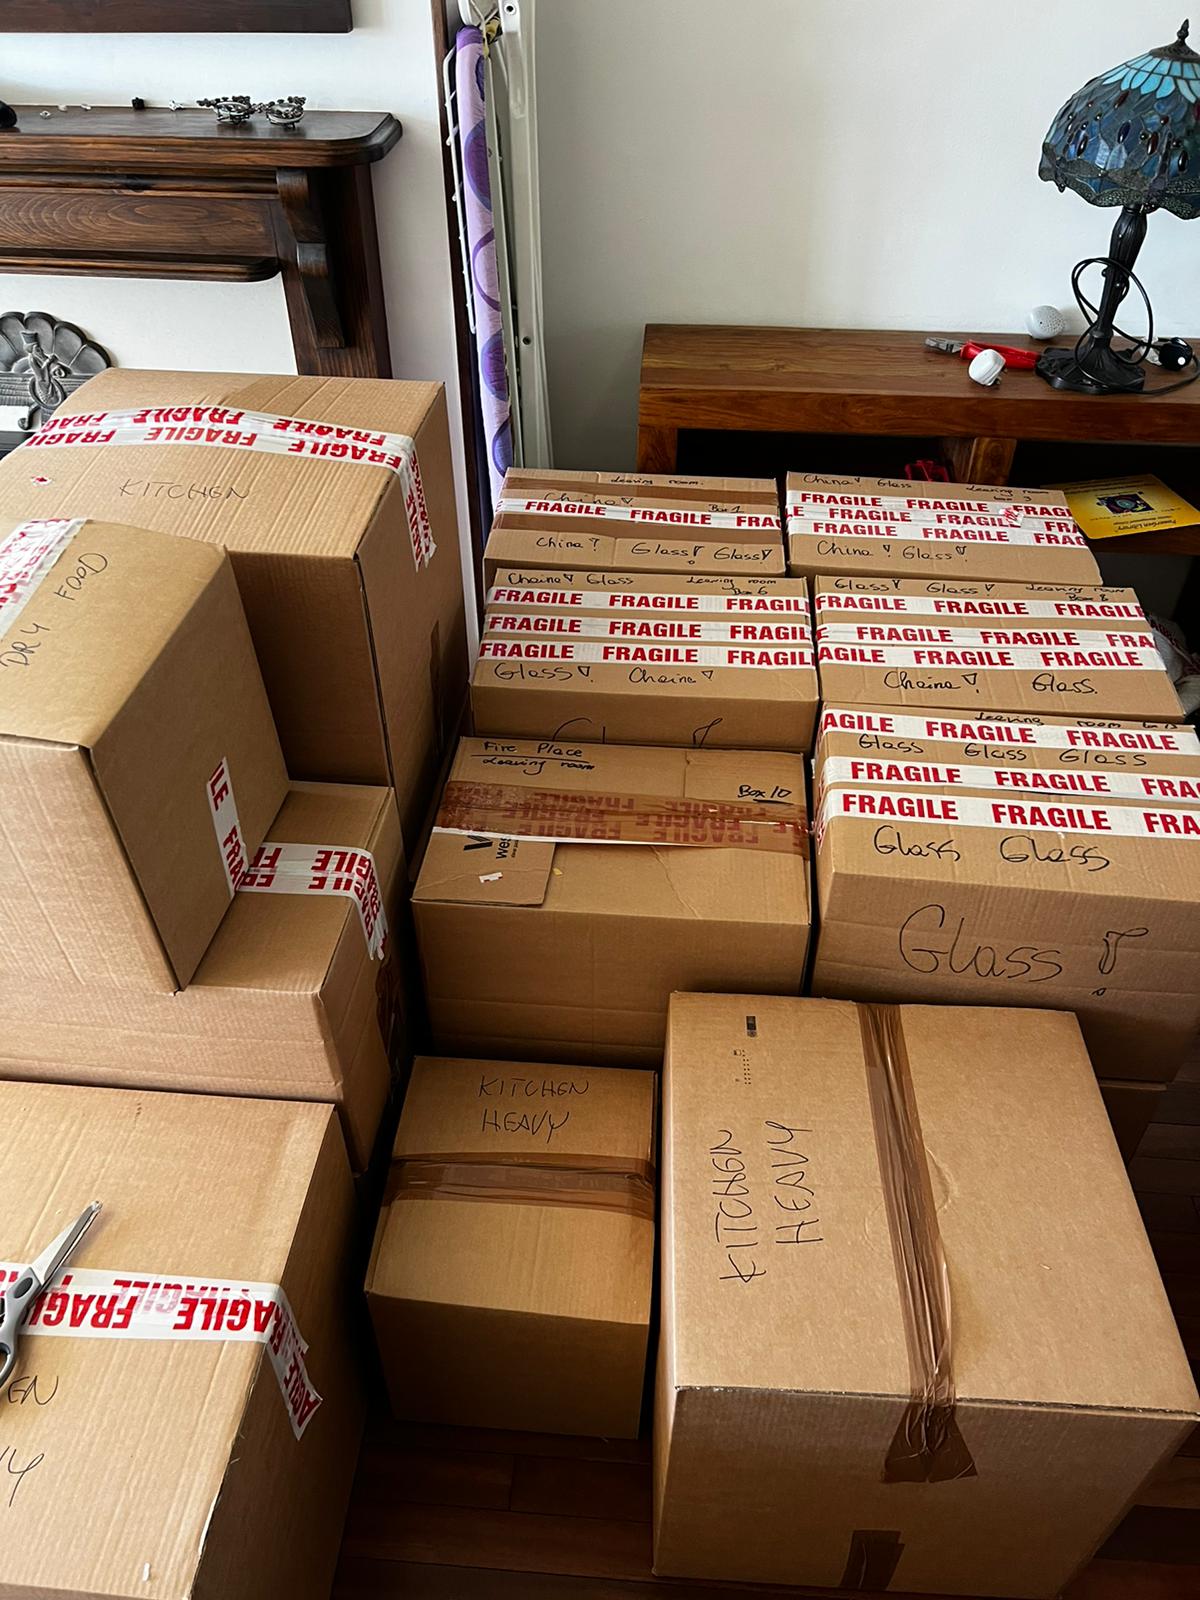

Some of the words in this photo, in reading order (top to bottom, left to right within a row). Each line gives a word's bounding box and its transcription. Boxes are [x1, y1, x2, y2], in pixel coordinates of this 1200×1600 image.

[133, 407, 245, 425] FRAGILE
[273, 419, 387, 446] FRAGILE
[144, 427, 258, 446] FRAGILE
[288, 440, 401, 469] FRAGILE
[120, 479, 249, 500] KITCHEN
[878, 479, 912, 488] Glass
[525, 501, 607, 516] FRAGILE
[630, 509, 712, 525] FRAGILE
[800, 493, 882, 507] FRAGILE
[907, 499, 990, 513] FRAGILE
[829, 508, 912, 522] FRAGILE
[813, 522, 898, 537] FRAGILE
[923, 528, 1009, 542] FRAGILE
[54, 552, 107, 600] FOOD
[587, 574, 635, 585] Glass
[494, 589, 583, 605] FRAGILE
[609, 594, 699, 610] FRAGILE
[817, 596, 907, 611] FRAGILE
[935, 601, 1029, 615] FRAGILE
[489, 617, 582, 633] FRAGILE
[609, 621, 702, 638] FRAGILE
[856, 627, 953, 643] FRAGILE
[980, 631, 1080, 646] FRAGILE
[480, 643, 574, 659] FRAGILE
[602, 646, 698, 663] FRAGILE
[914, 650, 1015, 666] FRAGILE
[1041, 652, 1143, 667] FRAGILE
[926, 721, 1037, 744] FRAGILE
[1067, 730, 1179, 751] FRAGILE
[484, 742, 516, 754] Fire
[537, 743, 583, 758] Place
[859, 734, 925, 754] Glass
[964, 743, 1027, 761] Glass
[1059, 749, 1148, 767] Glass
[738, 784, 766, 798] Box
[770, 786, 792, 798] 10
[851, 761, 963, 784] FRAGILE
[994, 770, 1111, 792] FRAGILE
[1141, 778, 1200, 799] FRA
[842, 794, 959, 820] FRAGILE
[992, 804, 1112, 830] FRAGILE
[874, 825, 961, 862] Glass
[1000, 835, 1111, 872] Glass
[900, 904, 1064, 983] Glass
[478, 1075, 589, 1098] KITCHEN
[482, 1108, 569, 1144] HEAVY
[765, 1121, 823, 1244] HEAVY
[710, 1129, 766, 1283] KITCHEN
